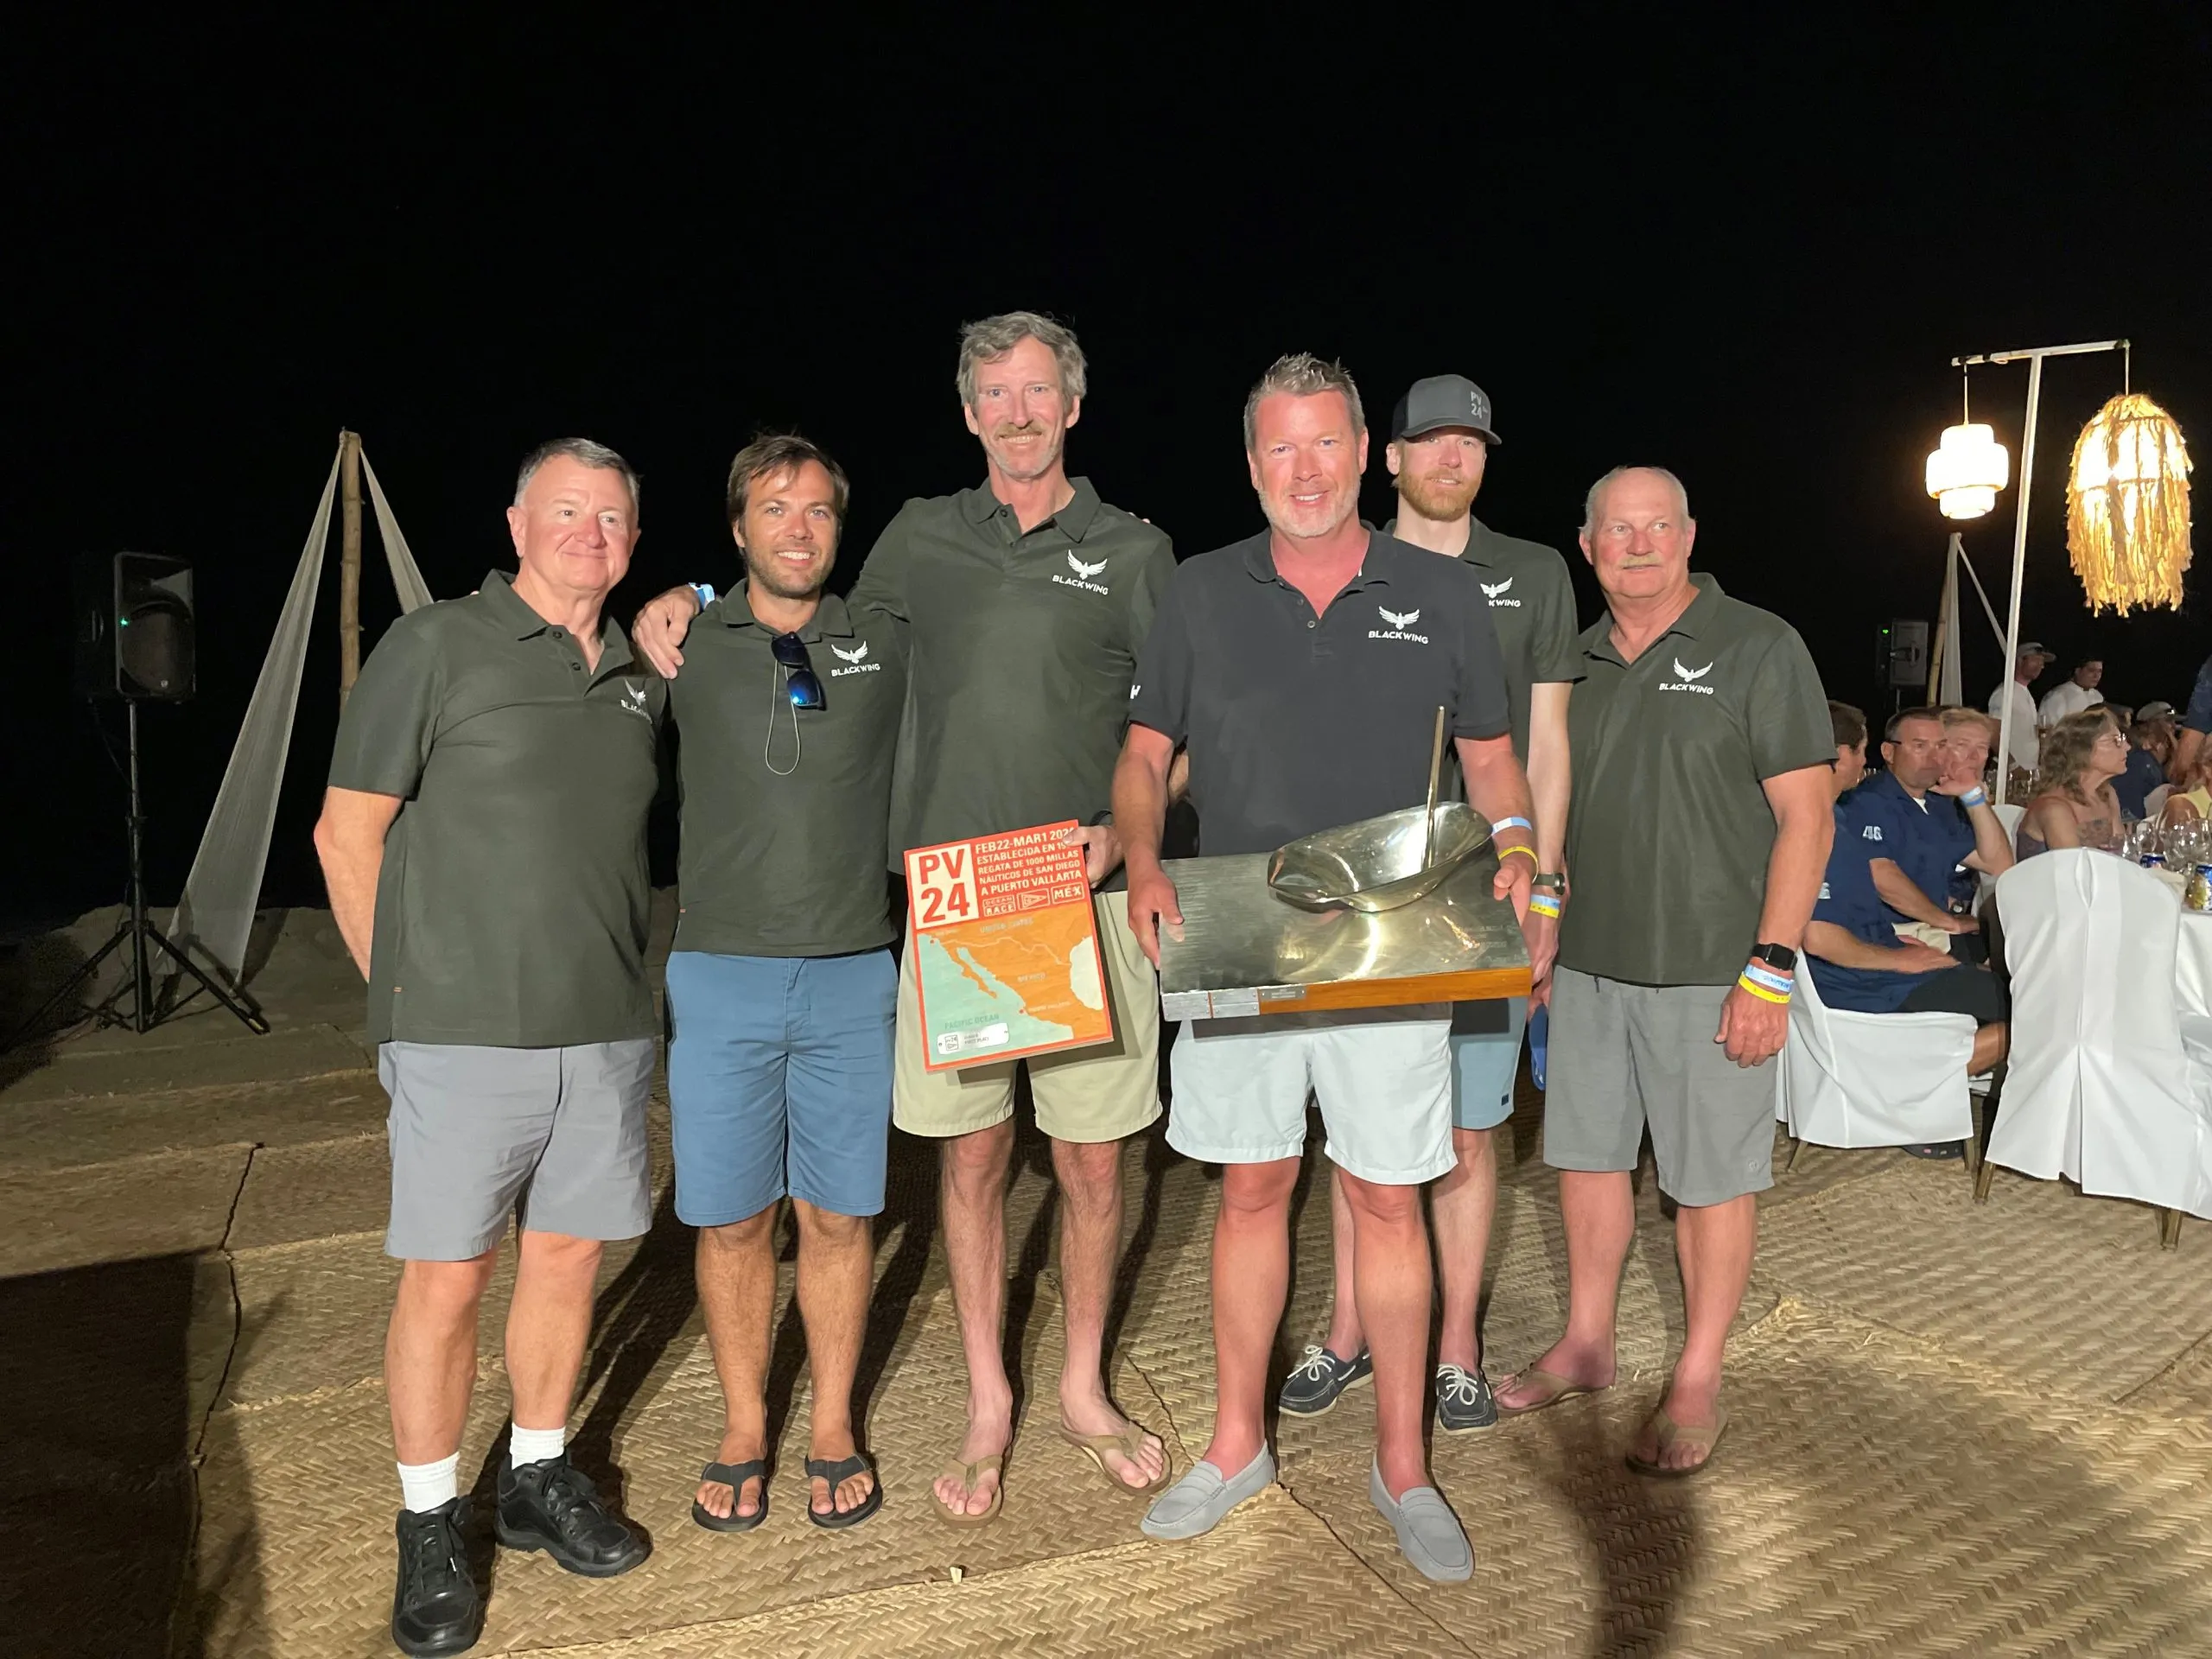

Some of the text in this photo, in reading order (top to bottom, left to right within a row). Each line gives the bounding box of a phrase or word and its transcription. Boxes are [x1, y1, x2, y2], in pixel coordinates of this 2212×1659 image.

[1471, 391, 1482, 405] PV
[1471, 403, 1483, 419] 24
[1052, 575, 1109, 595] BLACKWING
[1488, 599, 1522, 607] KWING
[1368, 630, 1429, 645] BLACKWING
[831, 663, 880, 677] BLACKWING
[1659, 683, 1714, 695] BLACKWING
[976, 847, 1041, 865] ESTABLECIDA
[1042, 843, 1055, 854] EN
[978, 862, 1011, 875] REGATA
[1026, 856, 1045, 866] 1000
[1046, 849, 1079, 862] MILLAS
[918, 848, 965, 885] PV
[1023, 868, 1034, 877] DE
[1035, 864, 1053, 874] SAN
[1055, 860, 1080, 871] DIEGO
[981, 869, 1082, 896] A PUERTO VALLARTA
[1054, 885, 1082, 899] MÉX
[920, 882, 970, 924] 24
[986, 904, 1014, 916] RACE
[944, 1014, 1000, 1030] PACIFIC OCEAN
